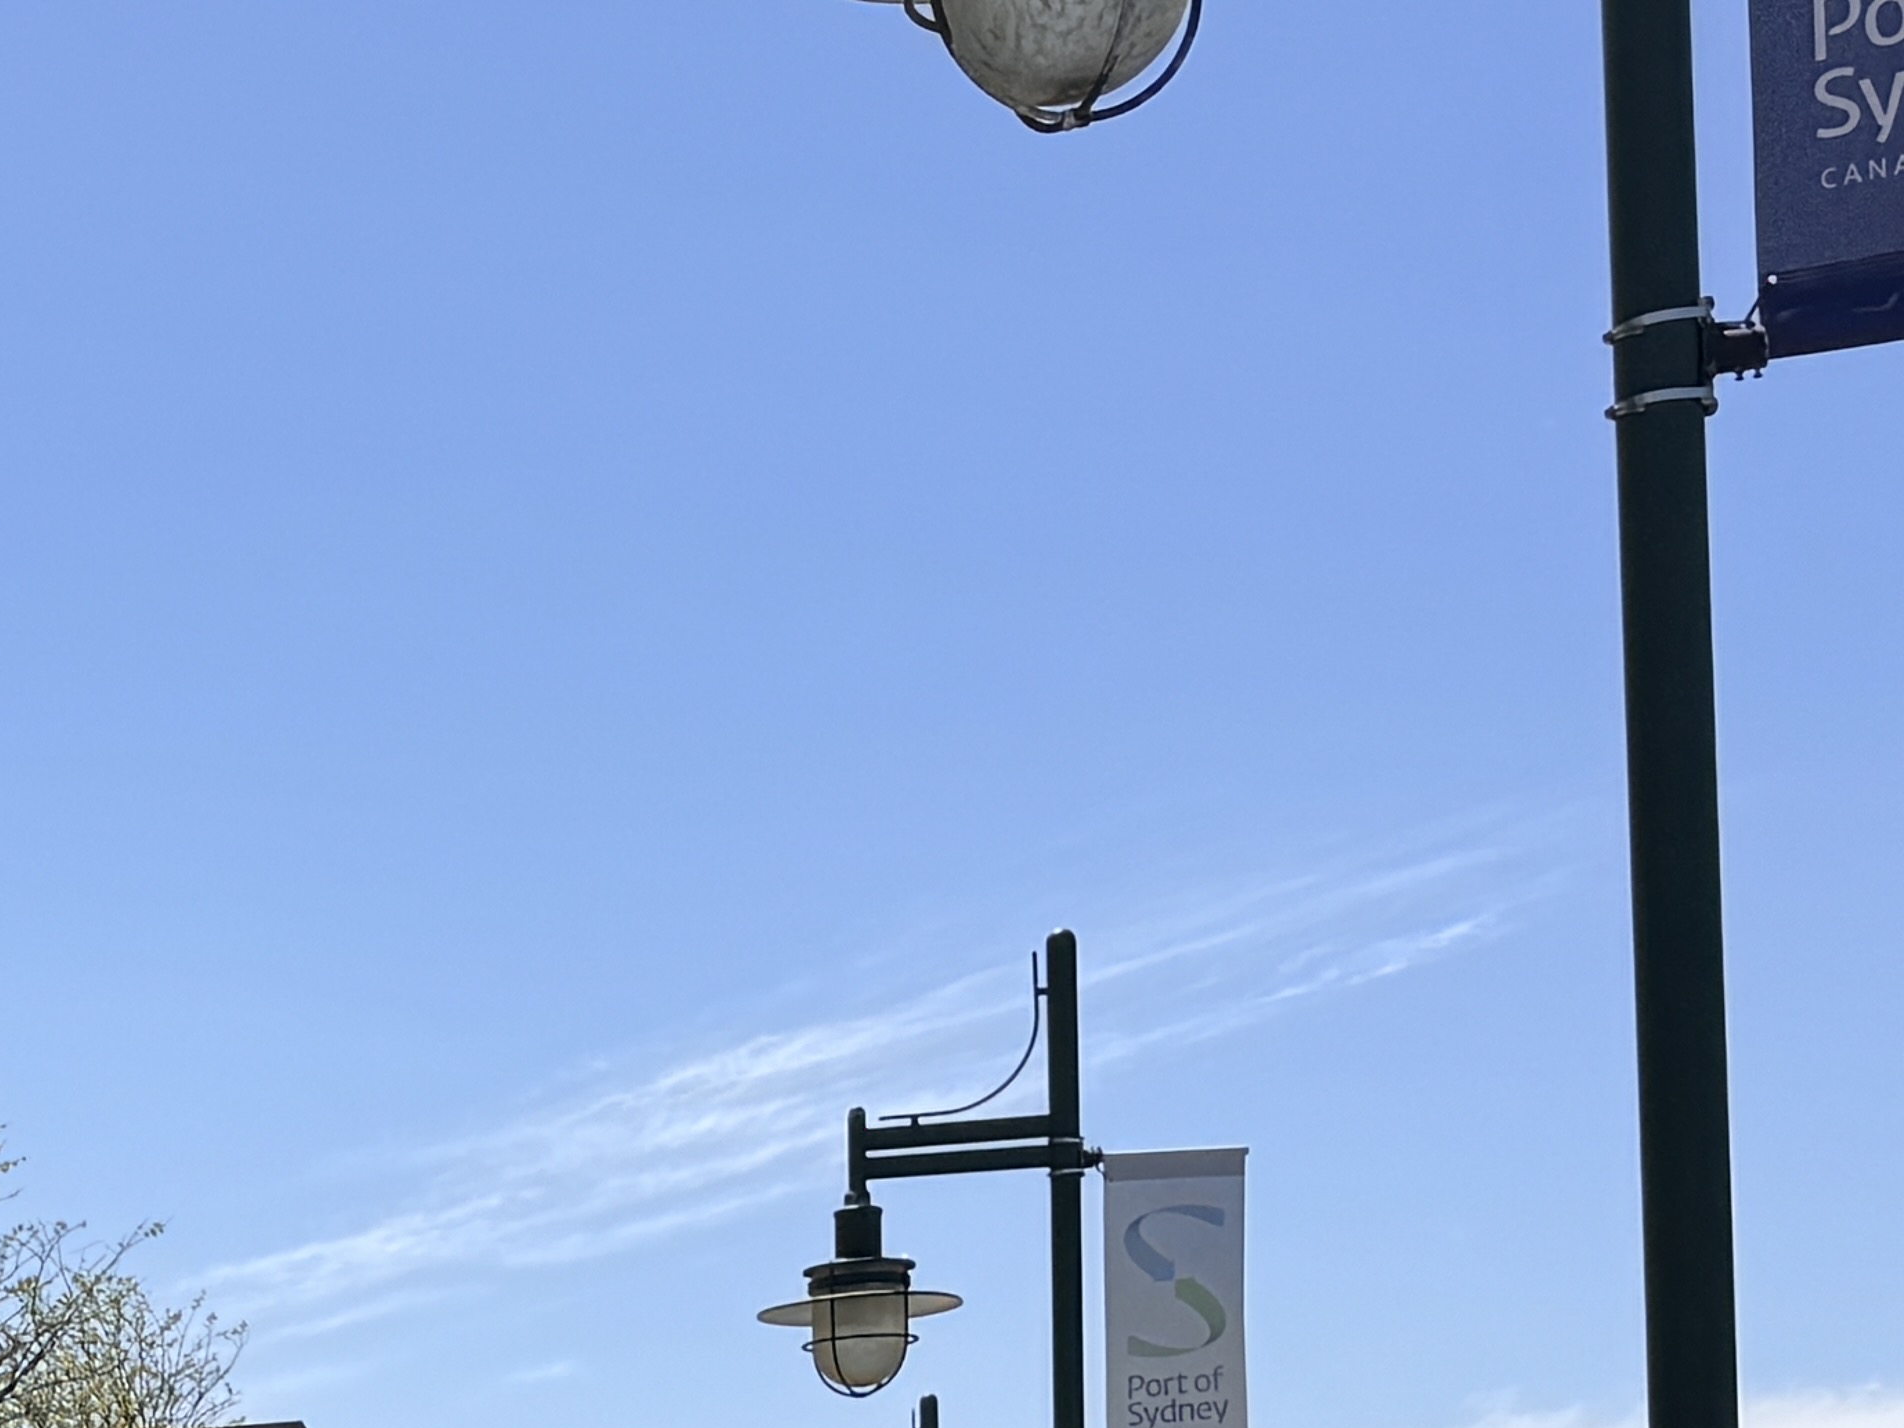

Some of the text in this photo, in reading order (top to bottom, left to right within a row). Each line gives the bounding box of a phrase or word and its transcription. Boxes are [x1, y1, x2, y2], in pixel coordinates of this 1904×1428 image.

[1128, 1365, 1224, 1399] Port of
[1128, 1399, 1228, 1428] Sydney
